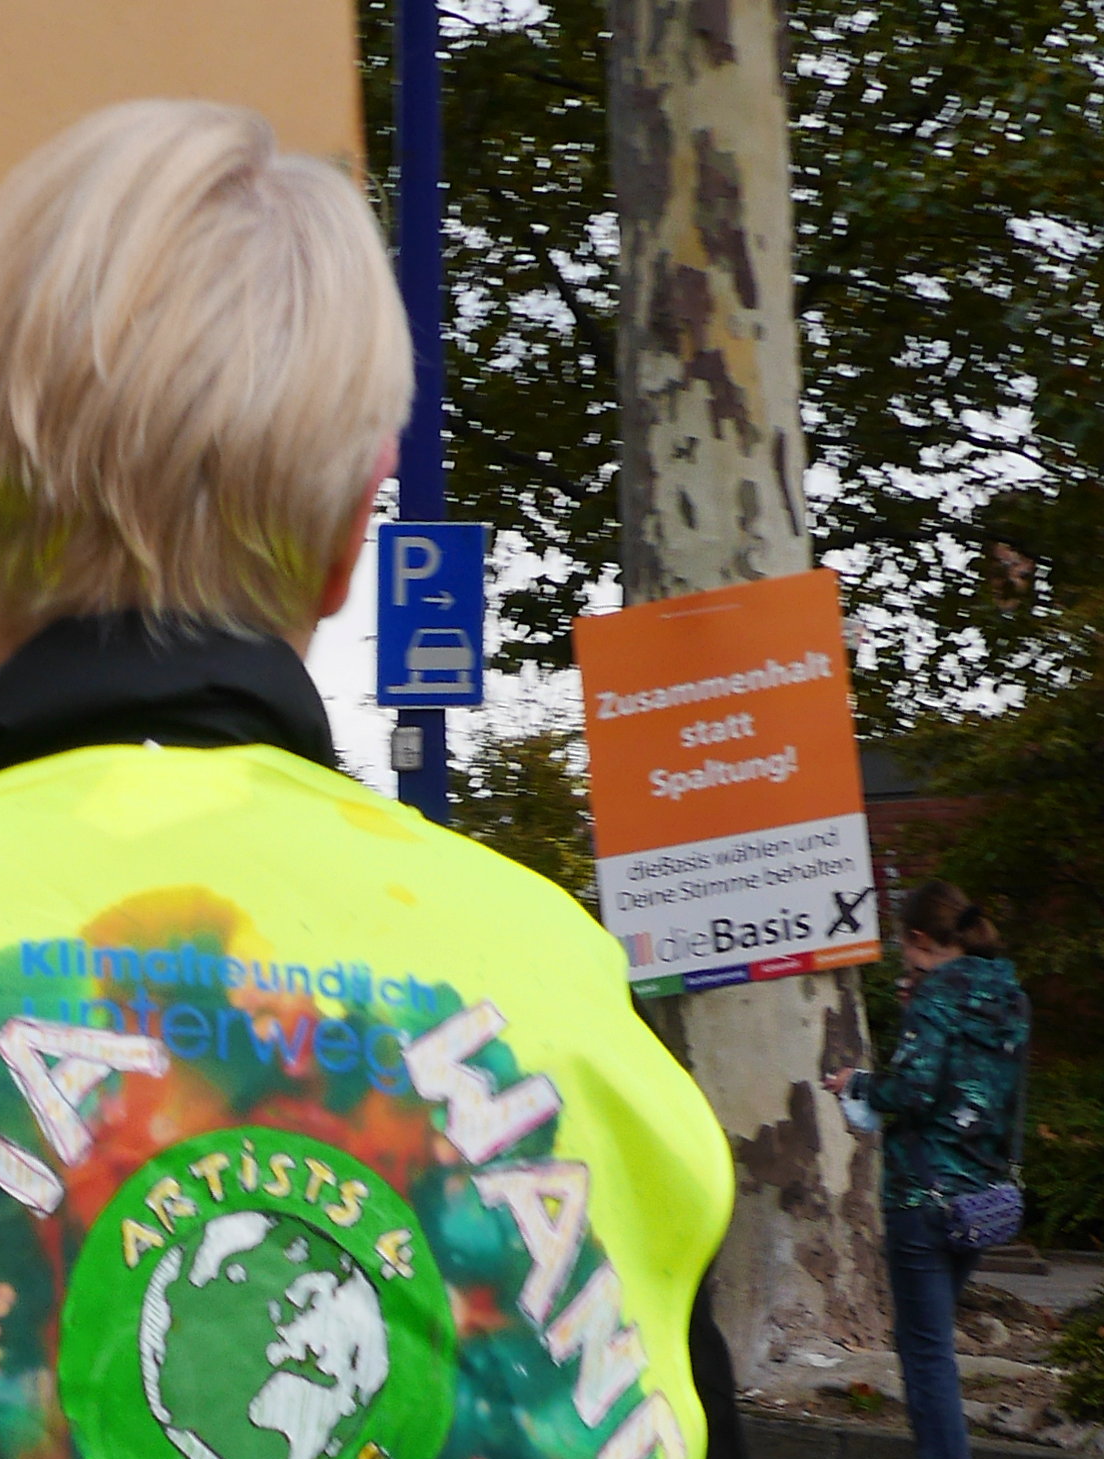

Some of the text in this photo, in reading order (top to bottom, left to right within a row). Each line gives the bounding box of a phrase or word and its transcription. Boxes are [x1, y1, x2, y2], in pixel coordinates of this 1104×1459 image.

[392, 536, 443, 606] P
[595, 650, 834, 721] Zusammenhalt
[679, 711, 757, 748] statt
[648, 744, 799, 801] Spaltung!
[655, 907, 812, 963] dieBasis
[19, 938, 438, 1013] Klimafreundlich
